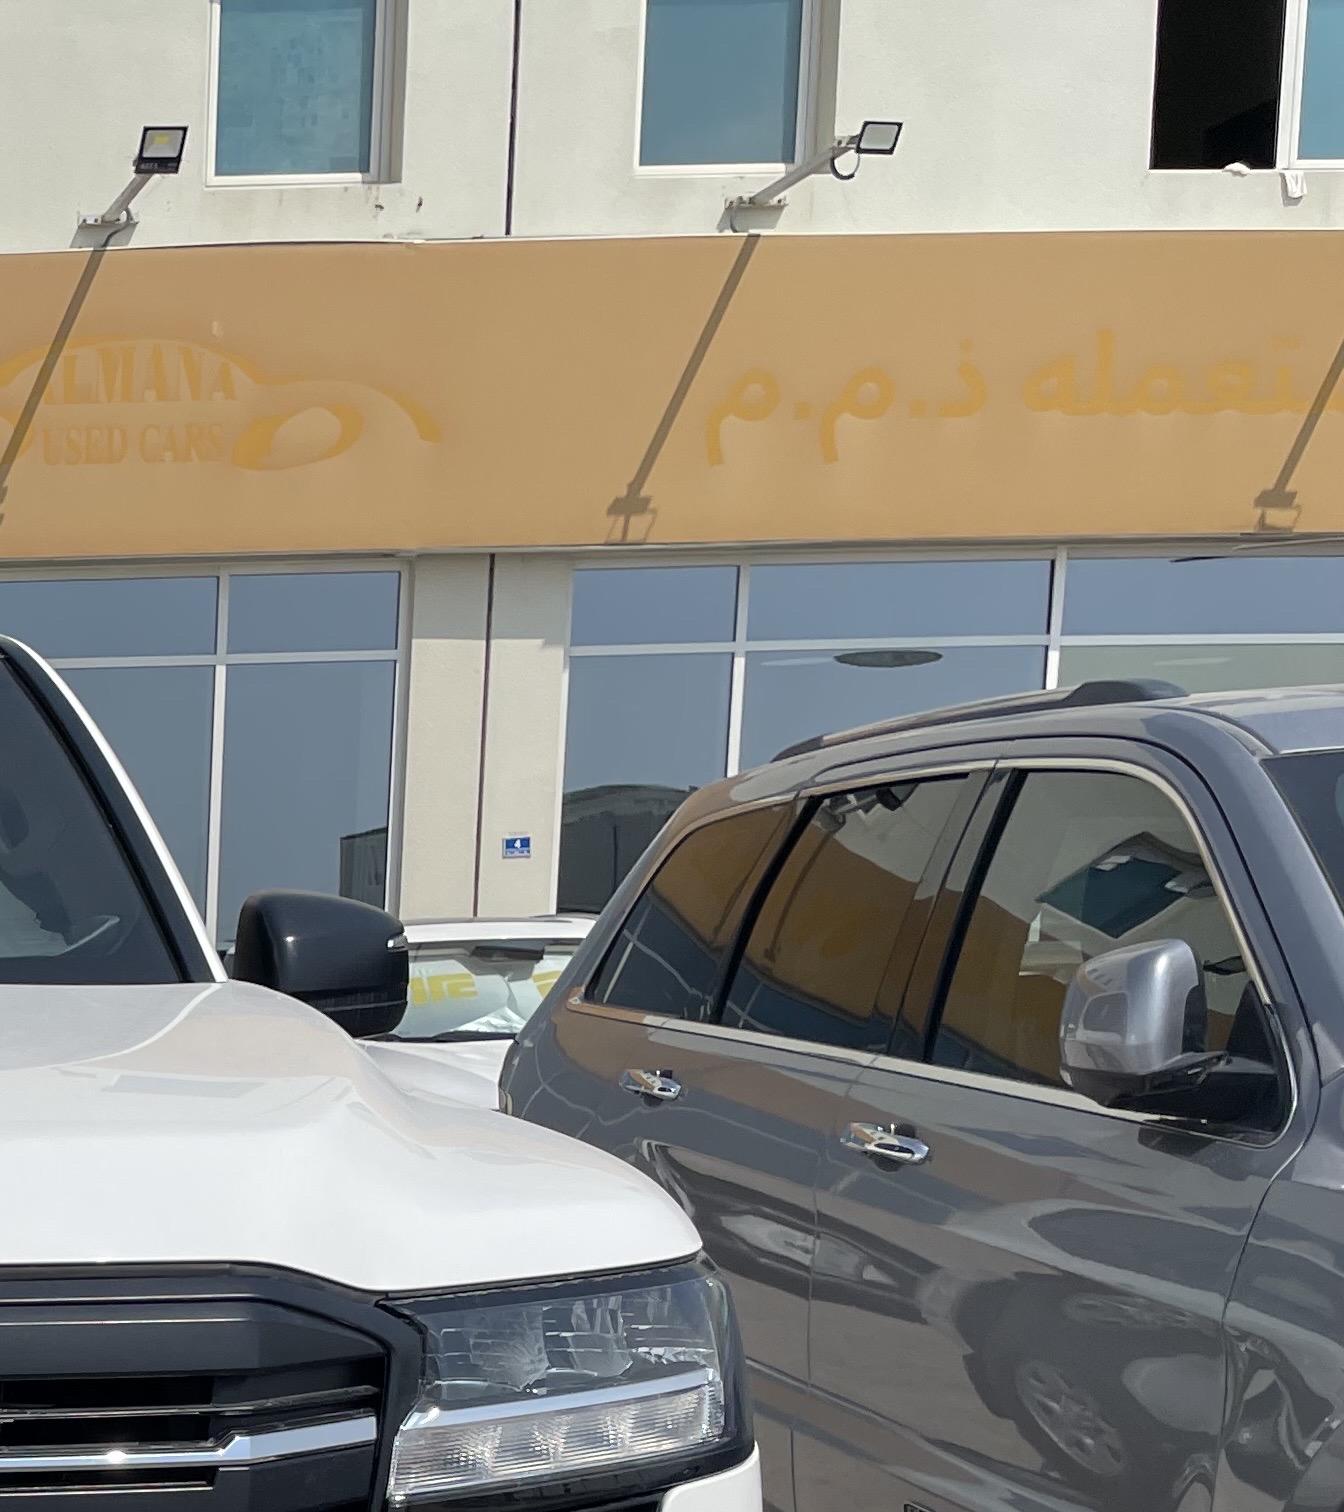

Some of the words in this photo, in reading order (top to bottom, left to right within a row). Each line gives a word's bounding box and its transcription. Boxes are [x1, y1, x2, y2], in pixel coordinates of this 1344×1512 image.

[1022, 327, 1344, 418] تعمله
[42, 424, 128, 466] USED
[139, 422, 223, 464] CARS
